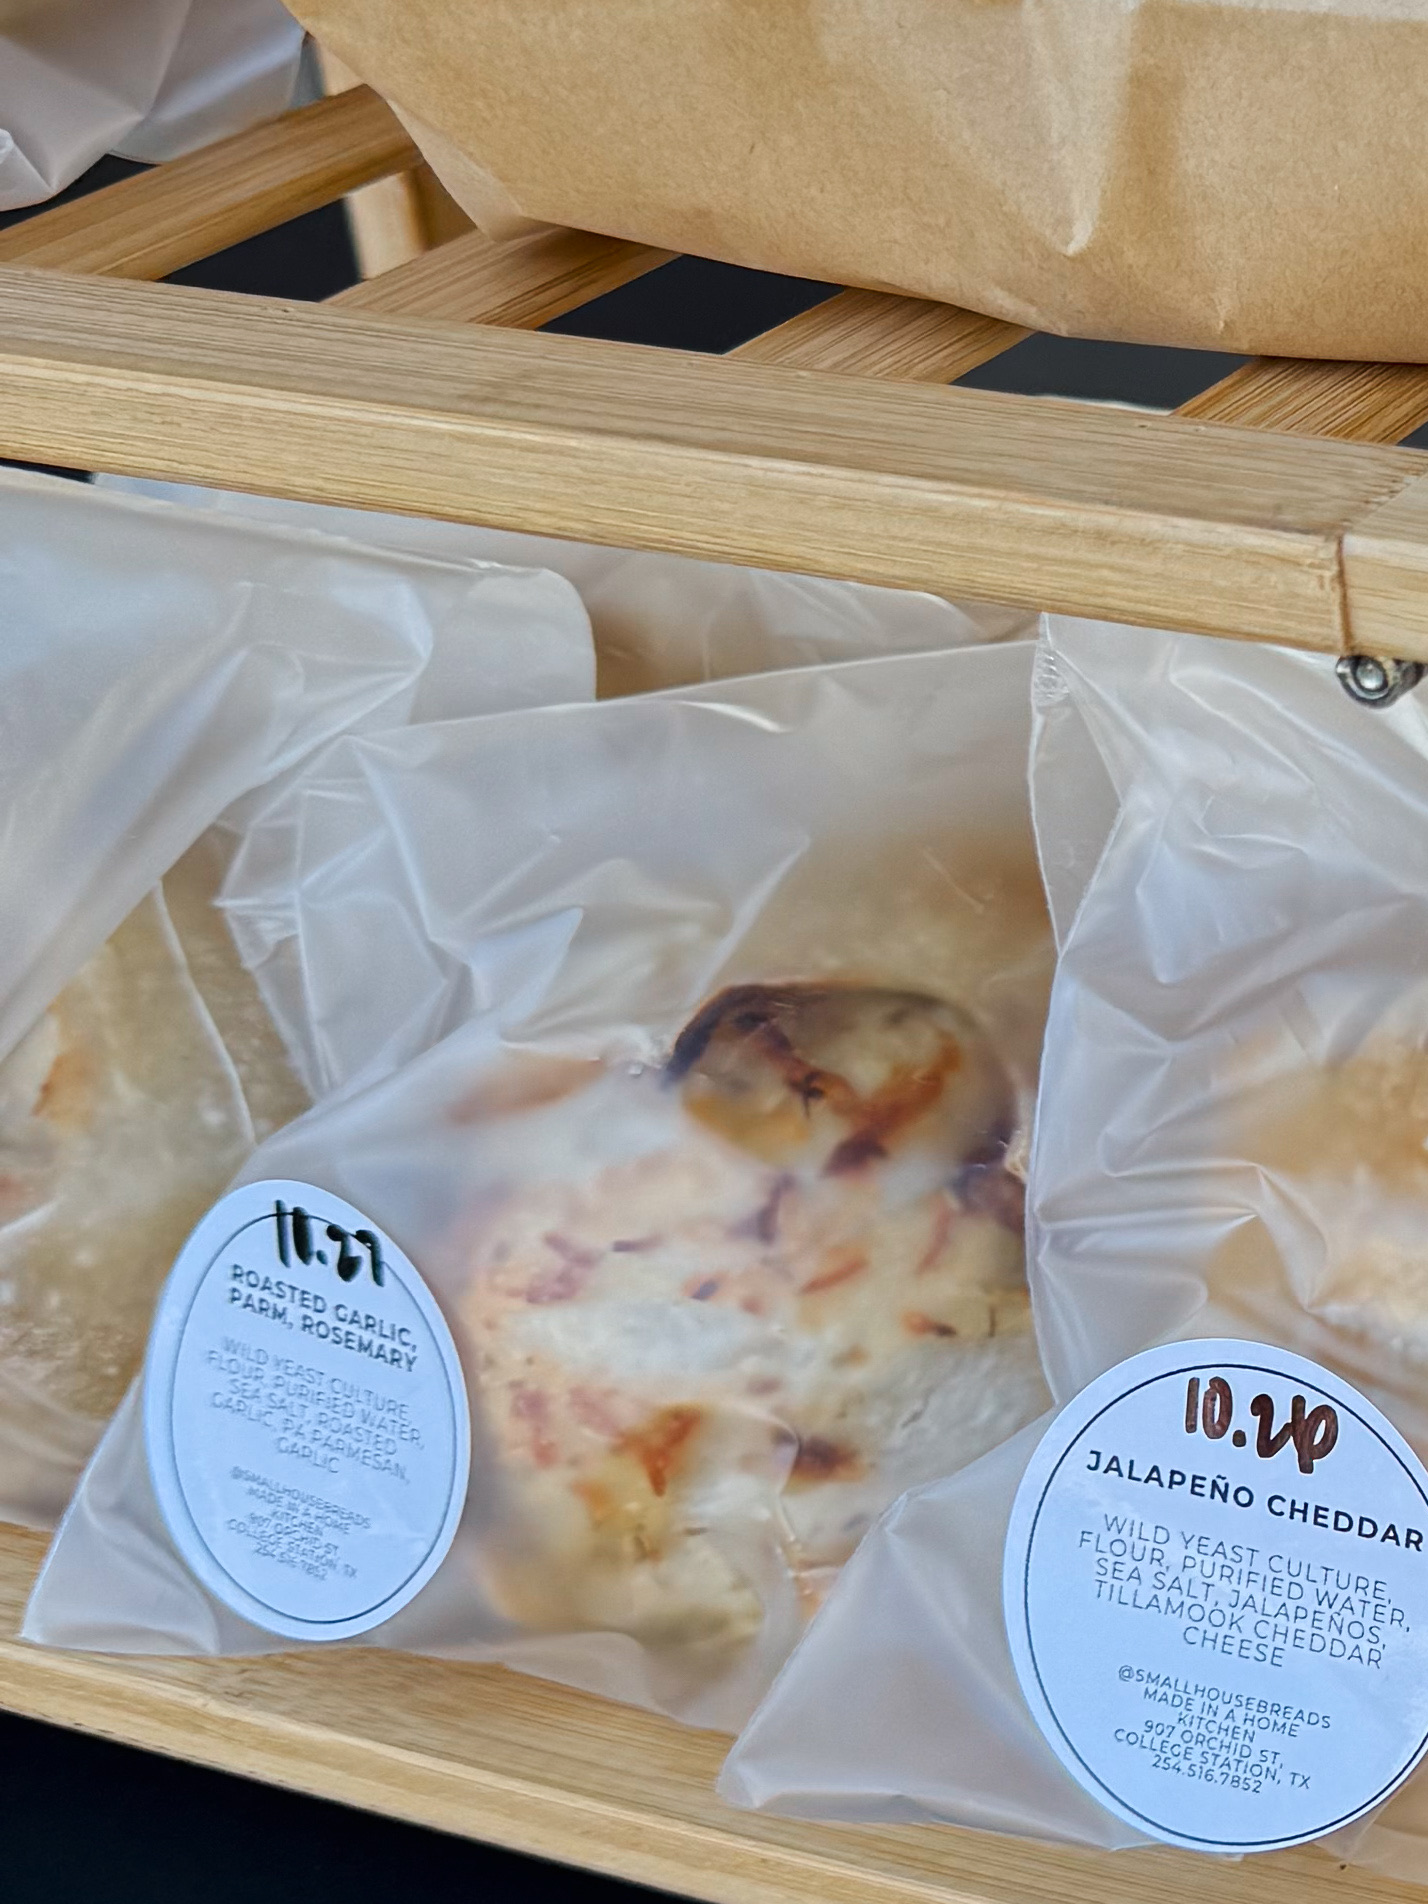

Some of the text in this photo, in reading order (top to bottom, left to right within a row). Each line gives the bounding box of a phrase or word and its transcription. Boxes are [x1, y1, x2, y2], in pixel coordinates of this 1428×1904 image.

[228, 1287, 418, 1373] PARM, ROSEMARY
[232, 1264, 417, 1353] ROASTED GARLIC,
[223, 1337, 268, 1365] WILD
[273, 1354, 325, 1386] YEAST
[229, 1378, 260, 1400] SEA
[319, 1412, 396, 1455] ROASTED
[273, 1375, 355, 1418] PURIFIED
[361, 1409, 424, 1449] WATER,
[277, 1436, 339, 1473] GARLIC
[1087, 1451, 1423, 1552] JALAPEÑO CHEDDAR
[1080, 1531, 1410, 1632] FLOUR, PURIFIED WATER,
[1104, 1513, 1391, 1604] WILD YEAST CULTURE,
[1096, 1558, 1386, 1649] SEA SALT, JALAPEÑOS,
[1096, 1580, 1382, 1669] TILLAMOOK CHEDDAR
[1183, 1627, 1285, 1667] CHEESE
[1119, 1665, 1331, 1728] @SMALLHOUSEBREADS
[1144, 1687, 1300, 1737] MADE IN A HOME
[1178, 1712, 1255, 1743] KITCHEN
[1115, 1729, 1311, 1789] COLLEGE STATION, TX
[1145, 1720, 1175, 1738] 907
[1181, 1730, 1251, 1758] ORCHID
[1153, 1755, 1262, 1793] 254.516.7852
